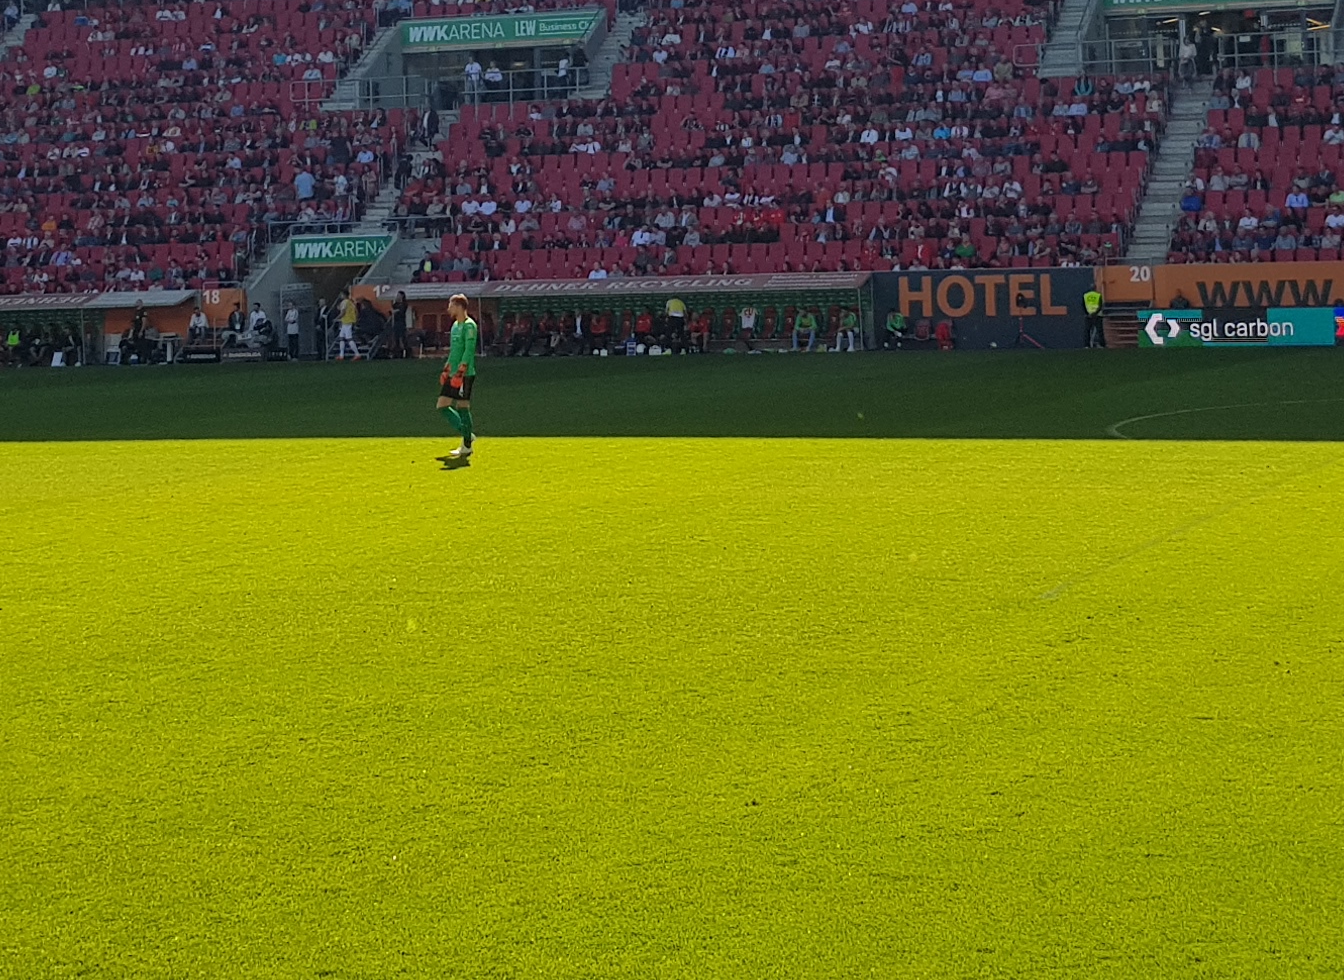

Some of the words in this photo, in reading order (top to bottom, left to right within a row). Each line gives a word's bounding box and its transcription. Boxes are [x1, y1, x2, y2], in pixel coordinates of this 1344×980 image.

[515, 19, 536, 36] LEW
[539, 22, 575, 33] Business
[1129, 265, 1151, 283] 20
[494, 280, 598, 292] DEHNER
[606, 277, 753, 290] RECYCLING
[202, 290, 221, 305] 18
[898, 273, 1068, 318] HOTEL
[1189, 318, 1219, 342] sgl
[1224, 318, 1294, 338] carbon
